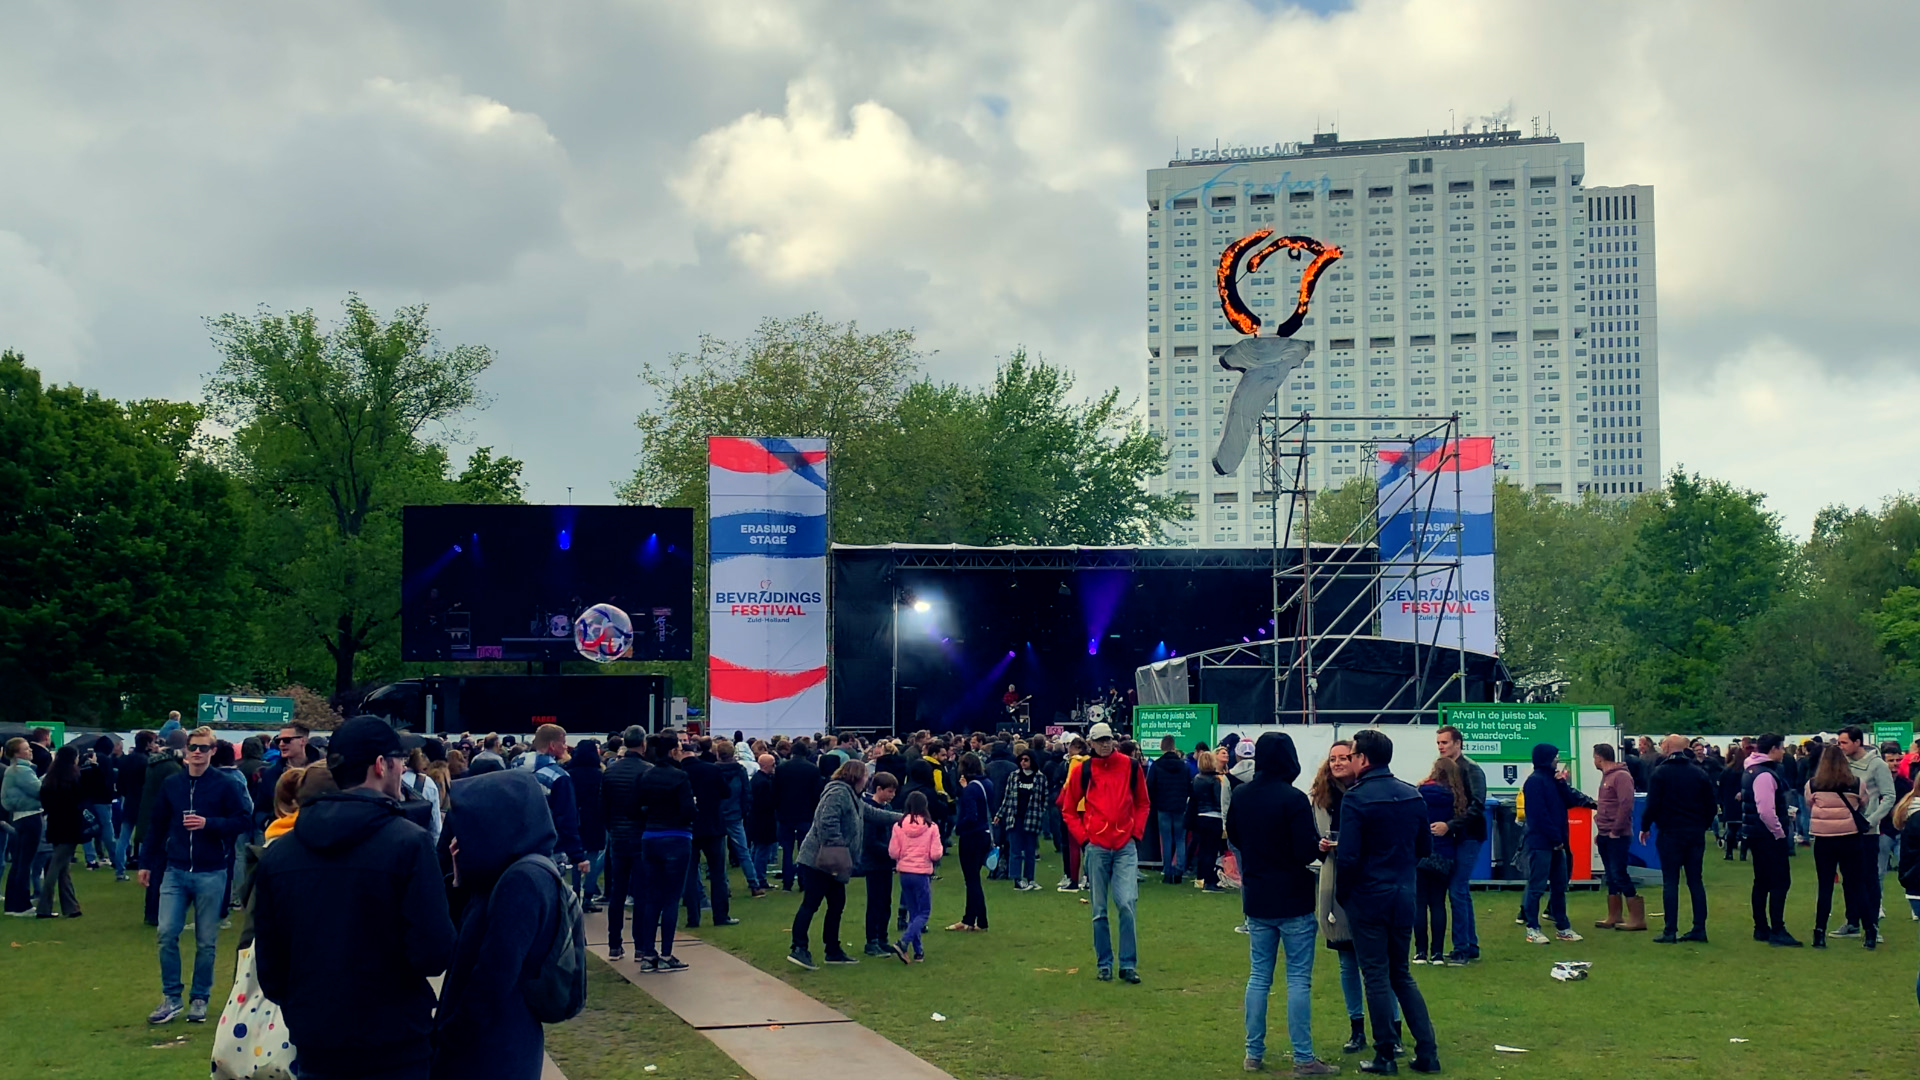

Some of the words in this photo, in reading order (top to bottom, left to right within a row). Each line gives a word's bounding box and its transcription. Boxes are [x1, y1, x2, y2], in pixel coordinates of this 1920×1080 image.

[1191, 145, 1270, 161] Erasmus
[1274, 141, 1302, 156] MC
[740, 525, 797, 534] ERASMUS
[749, 536, 788, 545] STAGE
[731, 605, 807, 616] FESTIVAL
[1401, 602, 1476, 614] FESTVAL
[282, 712, 290, 723] 2
[1141, 712, 1155, 720] Afval
[1156, 712, 1161, 720] in
[1162, 712, 1169, 720] de
[1170, 712, 1184, 721] juiste
[1186, 712, 1198, 720] bak,
[1452, 711, 1475, 719] Afval
[1477, 711, 1486, 719] in
[1488, 711, 1500, 719] de
[1501, 711, 1526, 721] juiste
[1528, 711, 1548, 721] bak,
[1167, 721, 1181, 730] terug
[1182, 720, 1191, 728] als
[1452, 722, 1464, 730] en
[1466, 721, 1479, 730] zie
[1481, 721, 1496, 730] het
[1497, 721, 1521, 731] terug
[1523, 721, 1537, 730] als
[1471, 743, 1499, 751] ziens!
